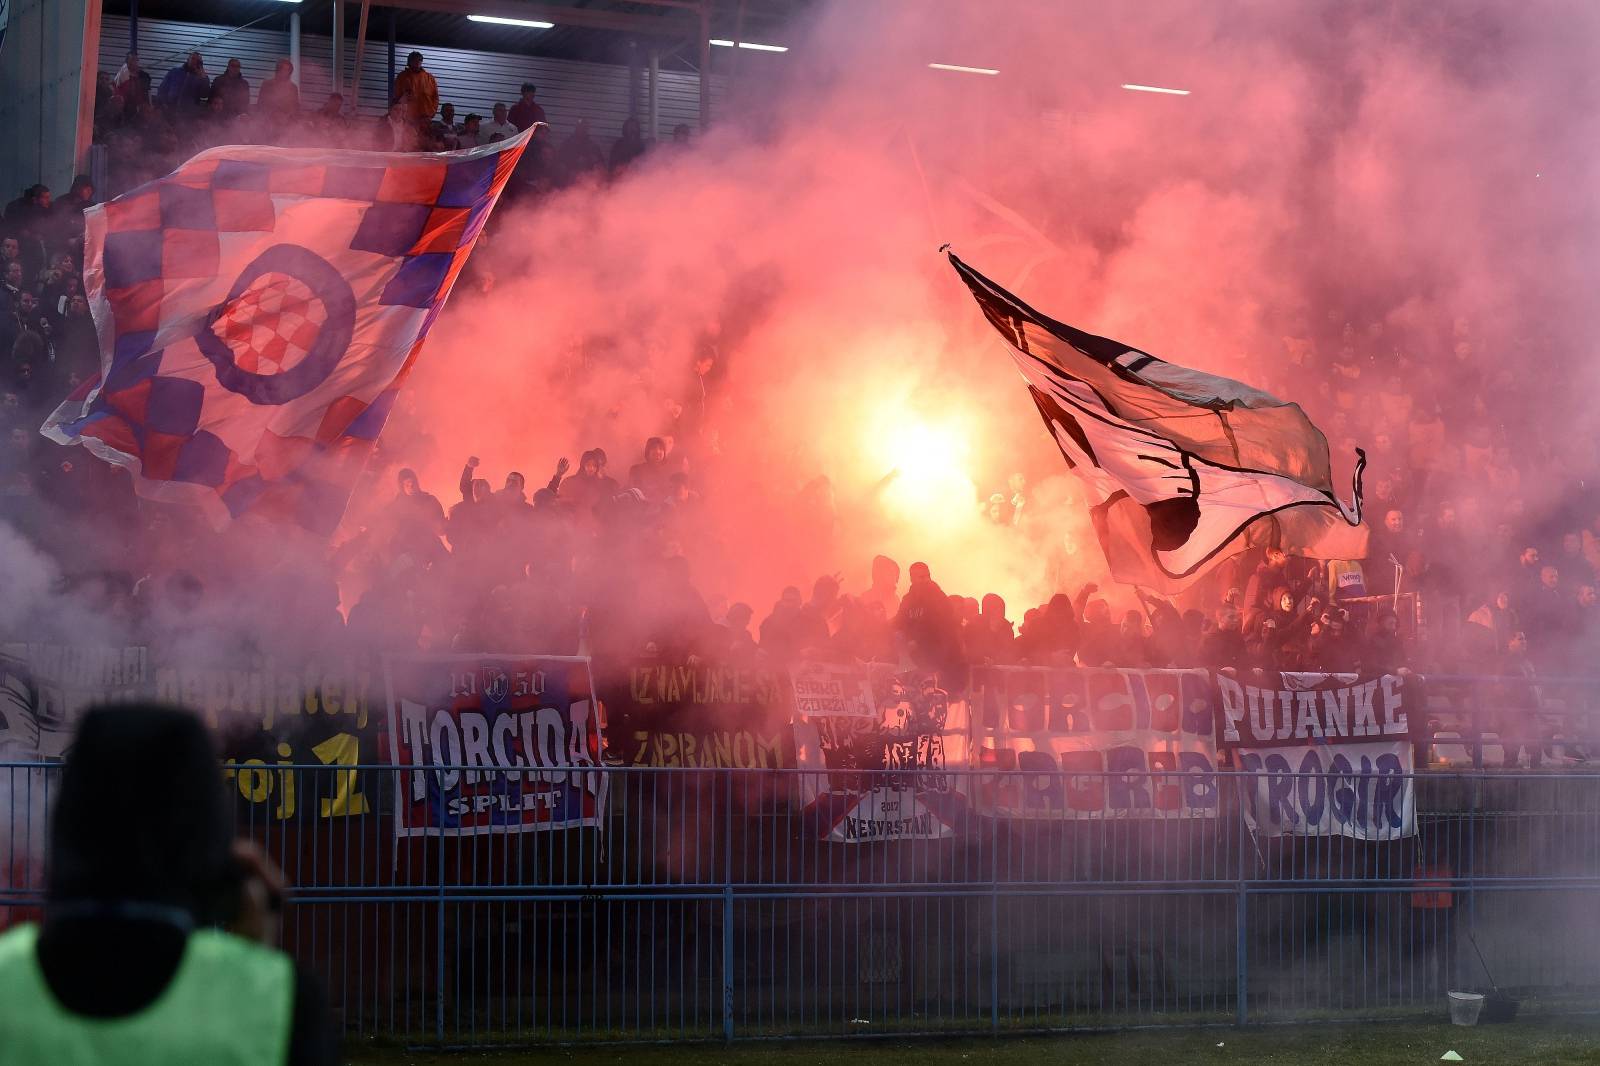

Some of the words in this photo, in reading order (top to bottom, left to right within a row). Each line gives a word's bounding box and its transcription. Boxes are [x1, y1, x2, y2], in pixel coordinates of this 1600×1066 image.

[450, 671, 476, 697] 19
[1217, 673, 1409, 742] PUJANKE
[311, 733, 371, 818] 1
[401, 697, 596, 802] TORCIDA
[979, 745, 1217, 811] ZAGREB
[448, 790, 562, 815] SPLIT
[1239, 750, 1403, 829] TROGIR
